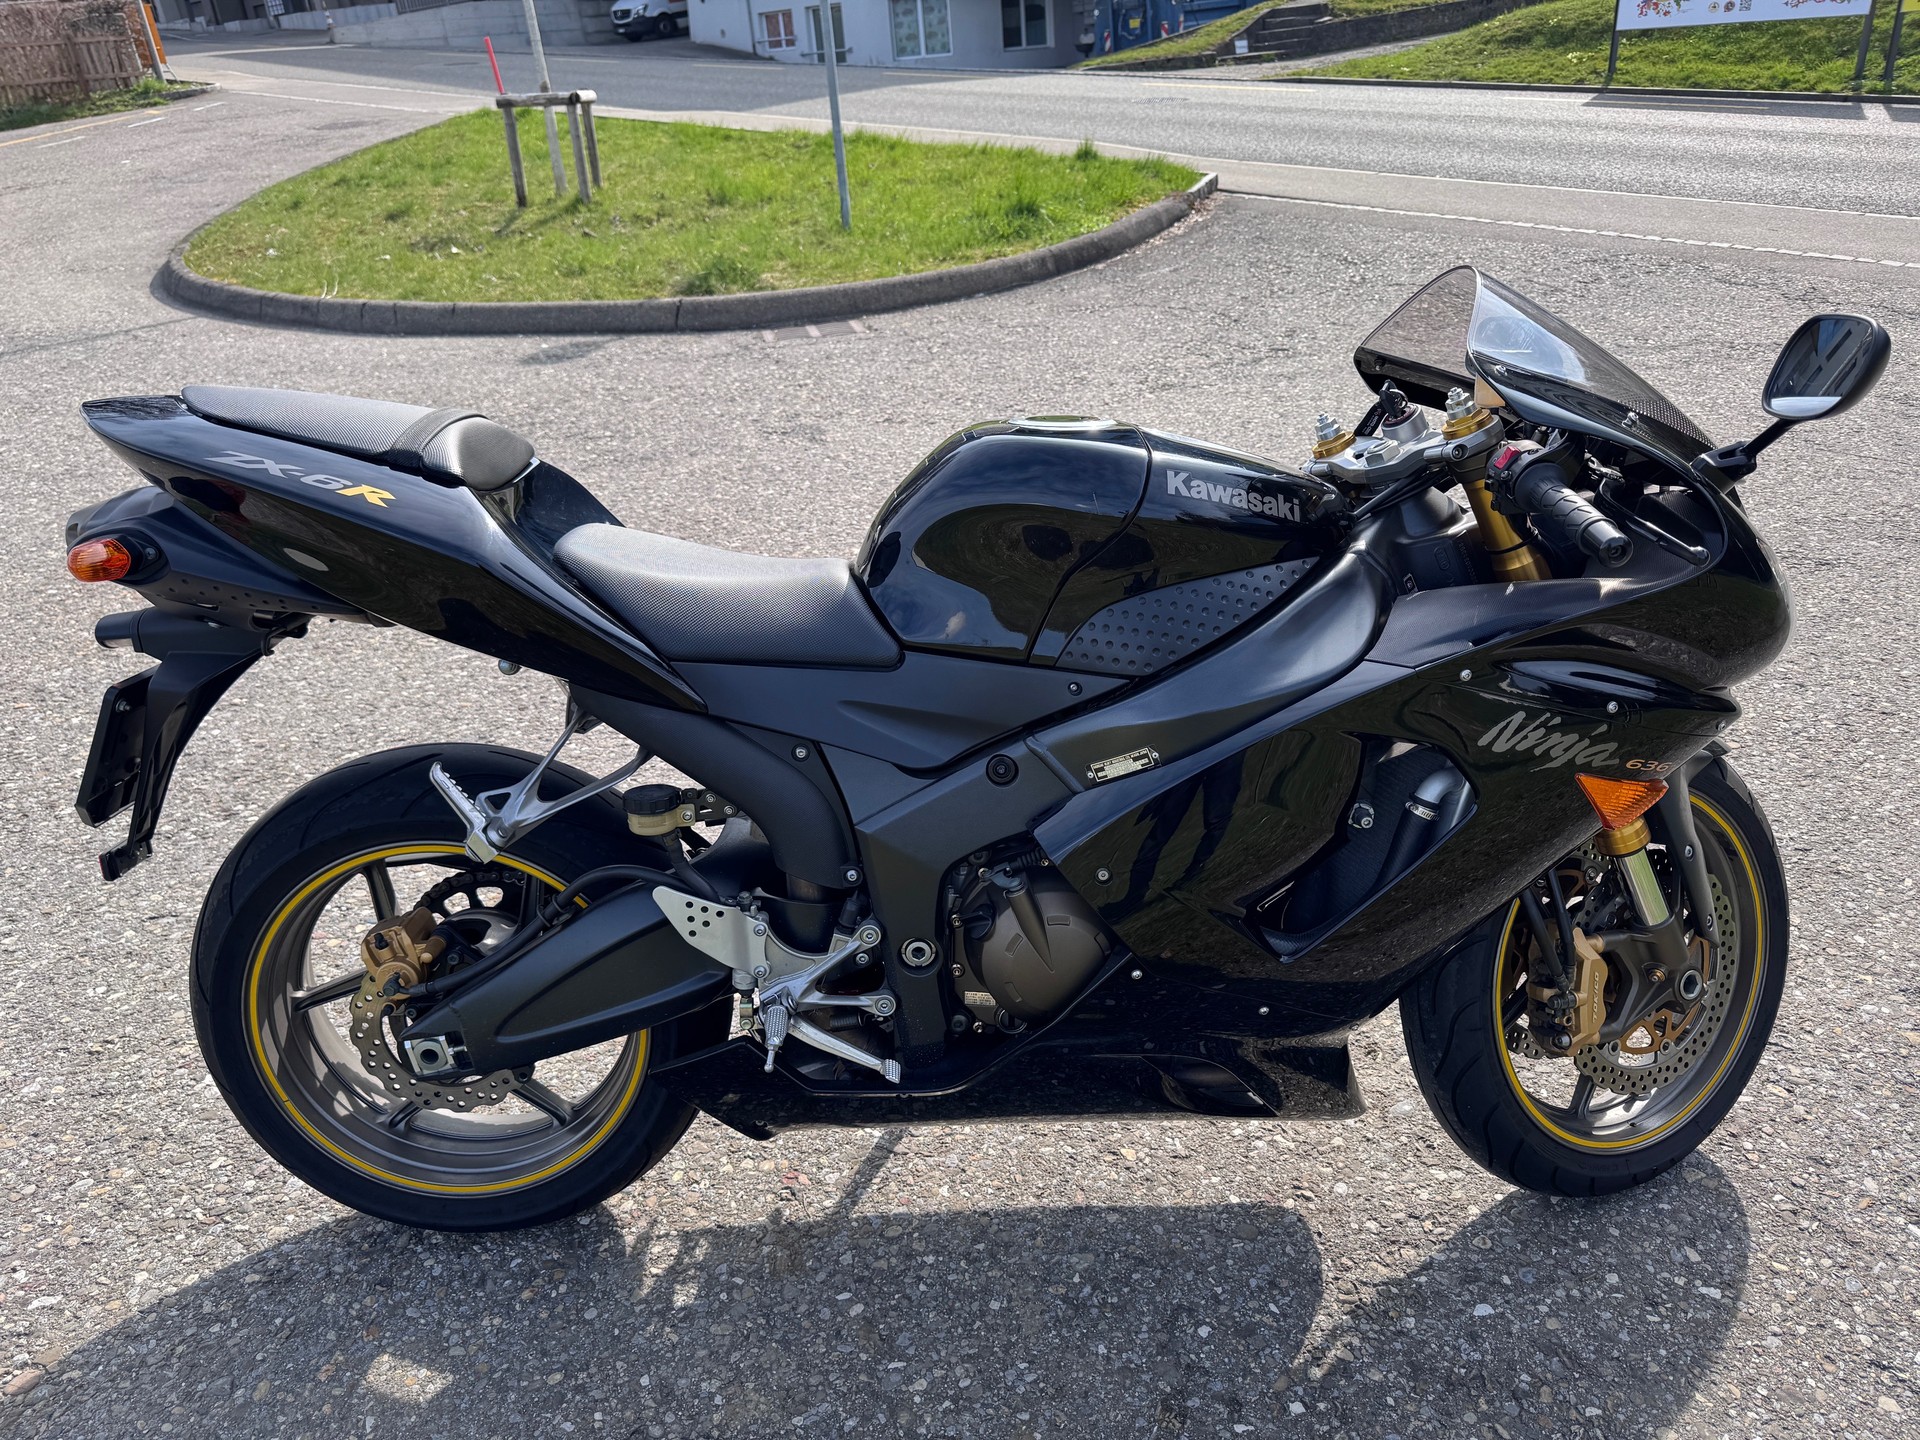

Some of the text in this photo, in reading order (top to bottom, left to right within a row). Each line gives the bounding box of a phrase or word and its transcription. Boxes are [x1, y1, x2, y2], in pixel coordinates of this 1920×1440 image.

[203, 450, 397, 508] ZX-6R
[1166, 469, 1301, 523] Kawasaki
[1477, 710, 1673, 773] Ninja 636
